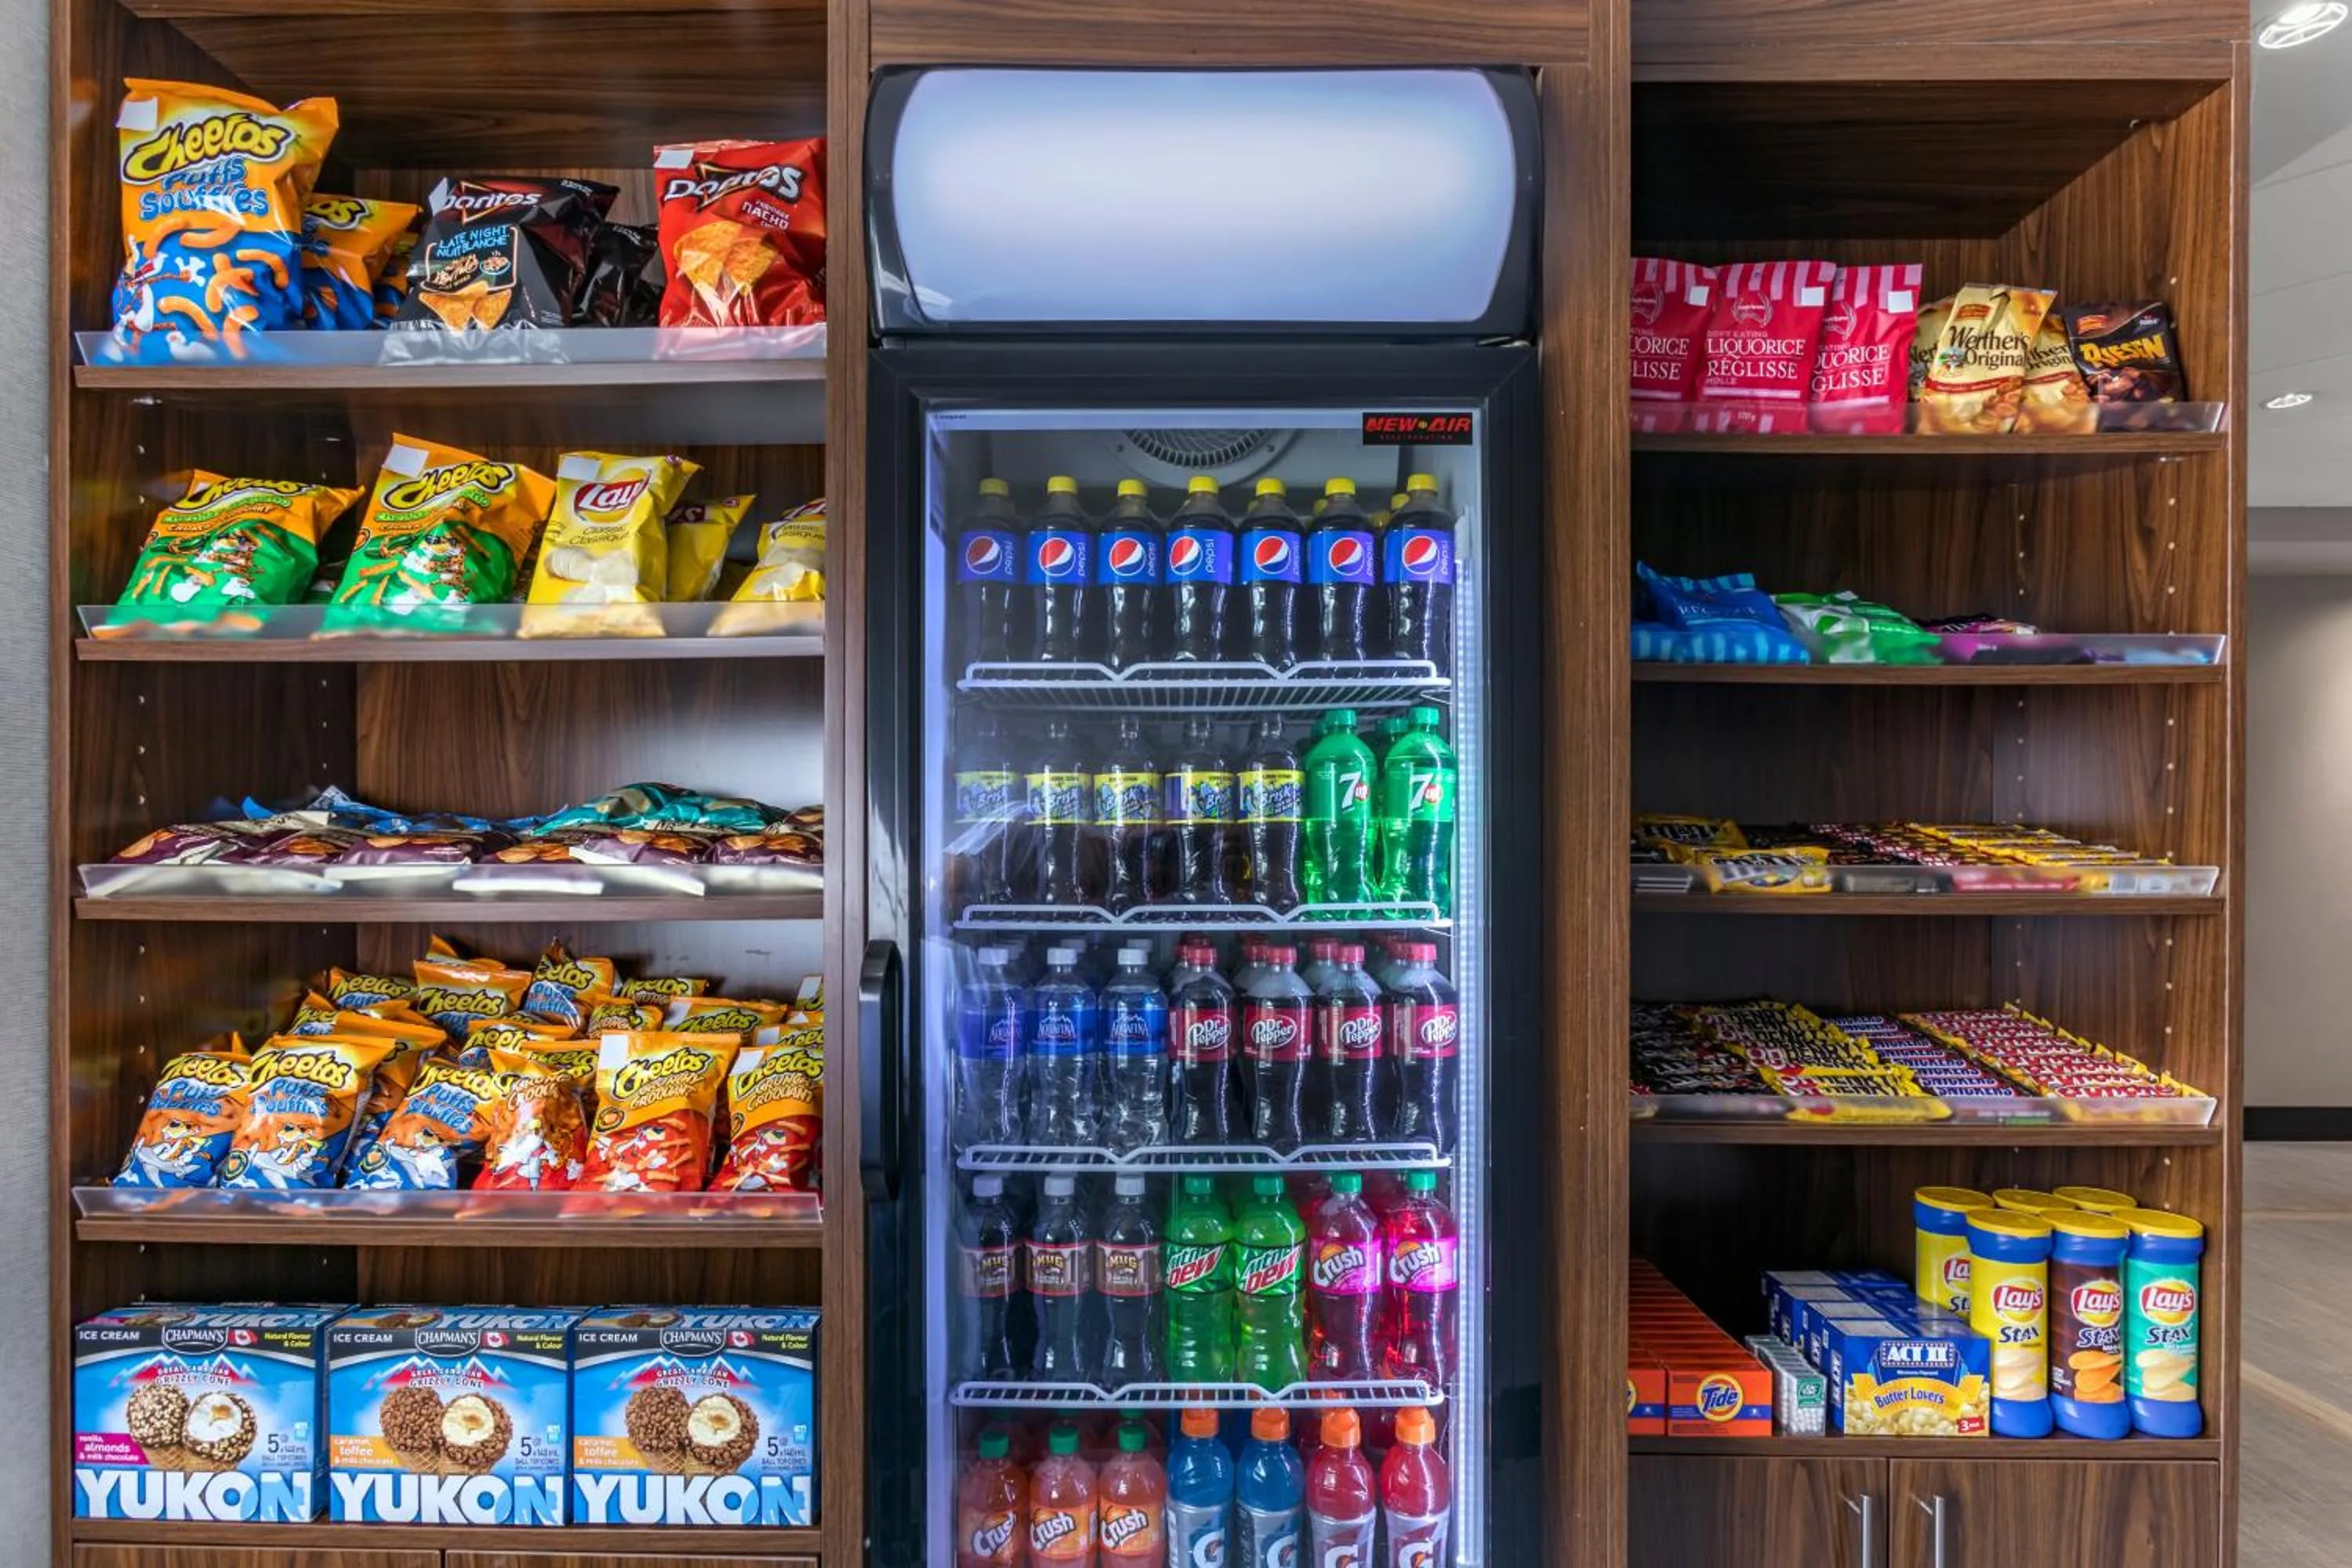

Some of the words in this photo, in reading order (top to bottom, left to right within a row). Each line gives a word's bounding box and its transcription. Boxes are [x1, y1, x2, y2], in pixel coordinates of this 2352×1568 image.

[125, 114, 289, 181] Cheetos
[664, 166, 803, 201] Doritos
[440, 233, 466, 248] LATE
[470, 225, 509, 240] NIGHT
[1708, 338, 1806, 359] LIQUORICE
[1949, 325, 2029, 351] Werther's
[1965, 349, 2027, 370] Original
[2079, 334, 2166, 368] RIESEN
[1707, 358, 1798, 379] RÉGLISSE
[1366, 416, 1417, 433] NEW
[385, 462, 511, 510] Cheetos
[1205, 539, 1216, 573] pepsi
[1440, 539, 1449, 575] pepsi
[1261, 782, 1294, 808] Brisk
[419, 988, 503, 1015] Cheetos
[1255, 1022, 1294, 1044] Pepper
[250, 1051, 352, 1092] Cheetos
[614, 1048, 710, 1098] Cheetos
[1035, 1255, 1064, 1268] MUG
[1109, 1255, 1138, 1269] MUG
[1313, 1245, 1364, 1287] Crush
[1389, 1242, 1441, 1283] Crush
[2145, 1288, 2193, 1312] Lay's
[80, 1331, 99, 1340] ICE
[100, 1331, 140, 1340] CREAM
[165, 1329, 225, 1342] CHAPMAN'S
[418, 1332, 477, 1344] CHAPMAN'S
[579, 1334, 597, 1342] ICE
[600, 1334, 637, 1342] CREAM
[663, 1331, 721, 1344] CHAPMAN'S
[1887, 1347, 1924, 1362] ACT
[1702, 1385, 1737, 1412] Tide
[1875, 1391, 1907, 1408] Butter
[1911, 1388, 1944, 1404] Lovers
[1961, 1420, 1969, 1431] 3
[85, 1443, 130, 1453] almonds
[267, 1433, 279, 1453] 5
[521, 1437, 532, 1457] 5
[768, 1436, 779, 1457] 5
[76, 1469, 311, 1521] YUKON
[330, 1474, 564, 1525] YUKON
[574, 1474, 812, 1525] YUKON
[1030, 1512, 1075, 1551] Crush
[1101, 1509, 1147, 1548] Crush
